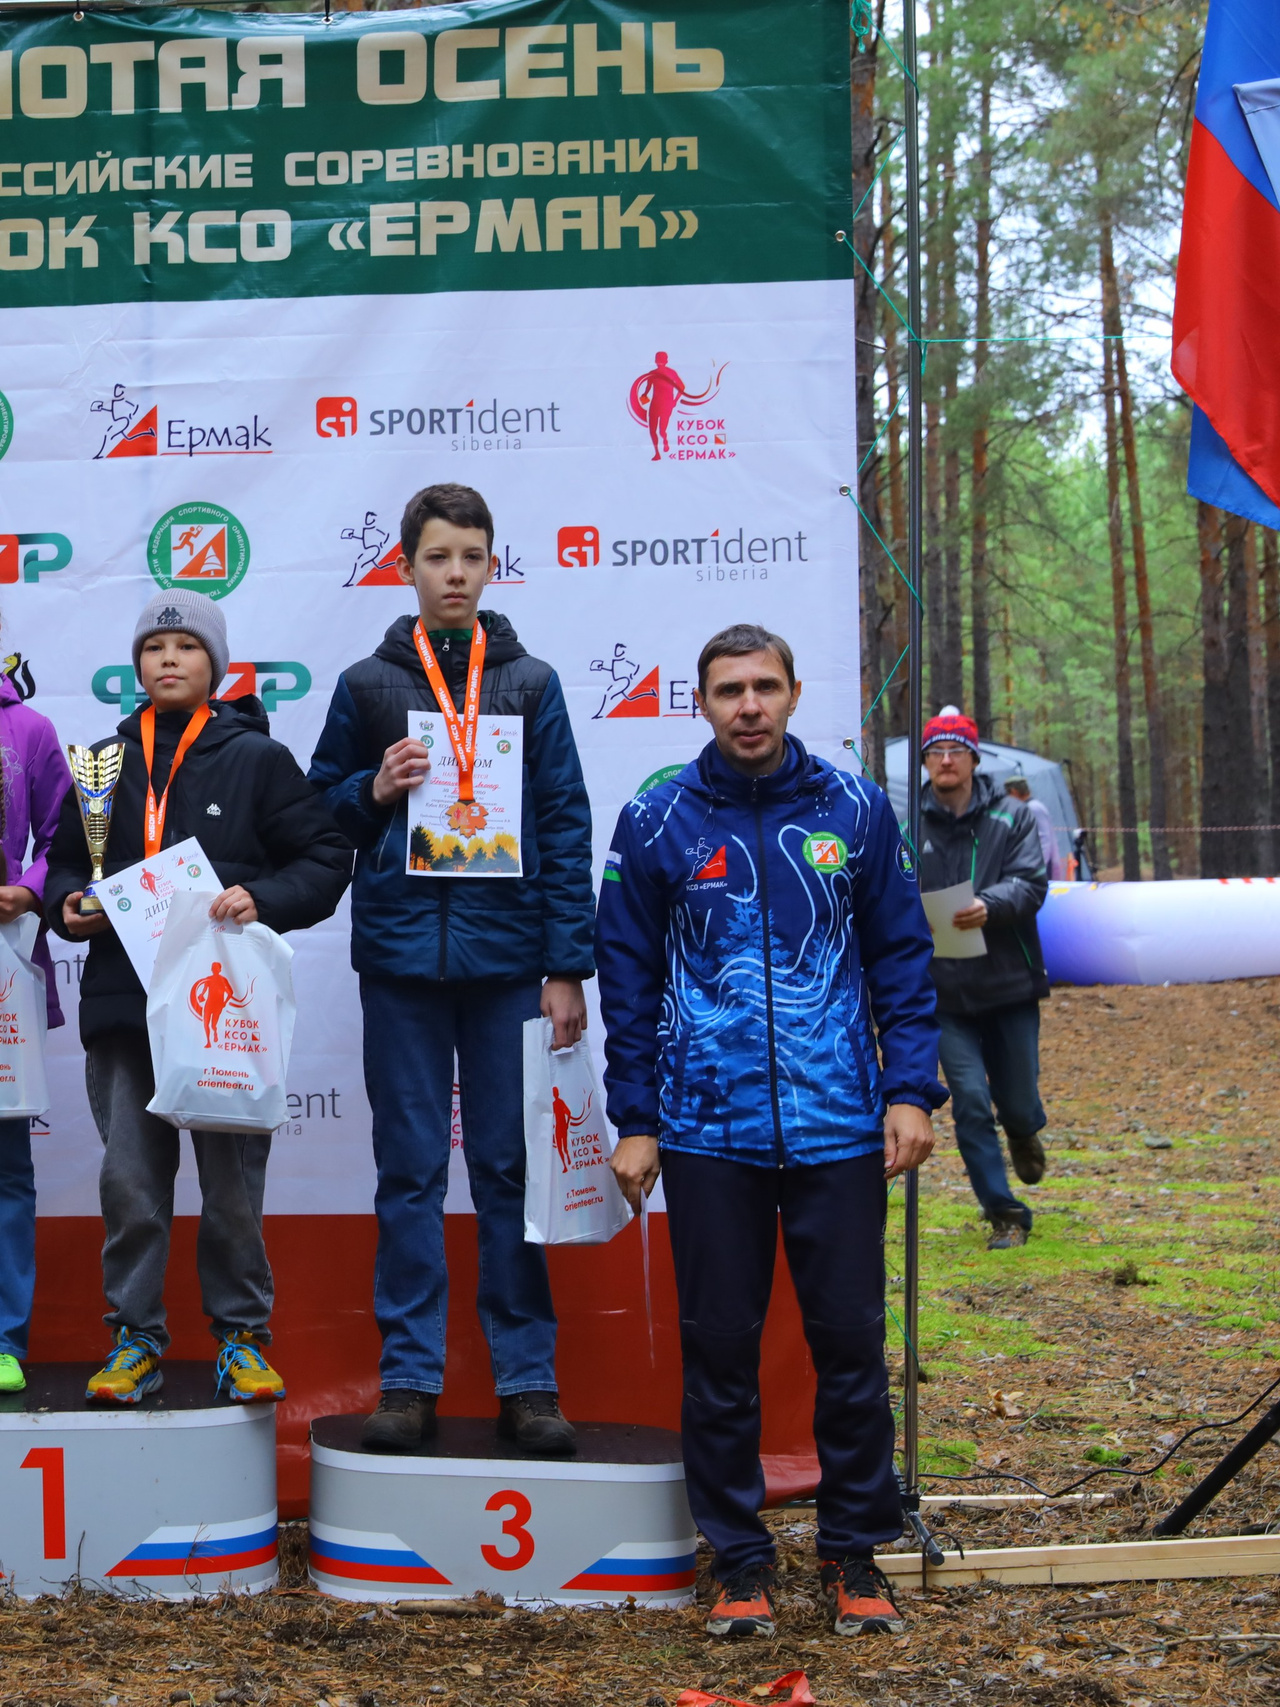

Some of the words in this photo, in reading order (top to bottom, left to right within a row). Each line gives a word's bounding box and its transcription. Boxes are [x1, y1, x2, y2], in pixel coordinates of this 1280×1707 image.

[356, 21, 725, 107] ОСЕНЬ
[283, 135, 700, 188] СОРЕВНОВАНИЯ
[133, 208, 292, 266] КСО
[327, 193, 700, 259] «ЕРМАК»
[369, 398, 561, 437] SPORTident
[676, 418, 726, 432] КУБОК
[166, 414, 272, 456] Ермак
[451, 434, 522, 452] siberia
[677, 433, 708, 446] КСО
[668, 448, 737, 461] «ЕРМАК»
[177, 506, 229, 522] СПОРТИВНОГО
[151, 515, 175, 555] ФЕДЕРАЦИЯ
[612, 528, 808, 566] SPORTident
[225, 525, 246, 588] ОРИЕНТИРОВАНИЯ
[152, 558, 173, 588] ОБЛАСТИ
[695, 564, 768, 581] siberia
[157, 617, 183, 627] Kappa
[416, 633, 435, 669] ТЮМЕНЬ
[470, 665, 480, 703] «ЕРМАК»
[467, 704, 476, 723] КСО
[450, 723, 461, 742] КСО
[464, 723, 474, 753] КУБОК
[438, 756, 493, 769] ДИОМ
[456, 743, 469, 772] КУБОК
[470, 806, 481, 816] 3
[148, 814, 156, 842] КУБОК
[686, 883, 699, 891] КСО
[224, 1018, 260, 1030] КУБОК
[224, 1031, 248, 1041] КСО
[216, 1042, 269, 1054] «ЕРМАК»
[203, 1066, 250, 1080] г.Тюмень
[197, 1077, 255, 1092] orienteer.ru
[570, 1133, 600, 1147] КУБОК
[572, 1147, 590, 1158] КСО
[571, 1156, 610, 1170] «ЕРМАК»
[566, 1185, 597, 1199] г.Тюмень
[564, 1196, 604, 1212] orienteer.ru
[20, 1447, 67, 1561] 1
[480, 1489, 535, 1573] 3
